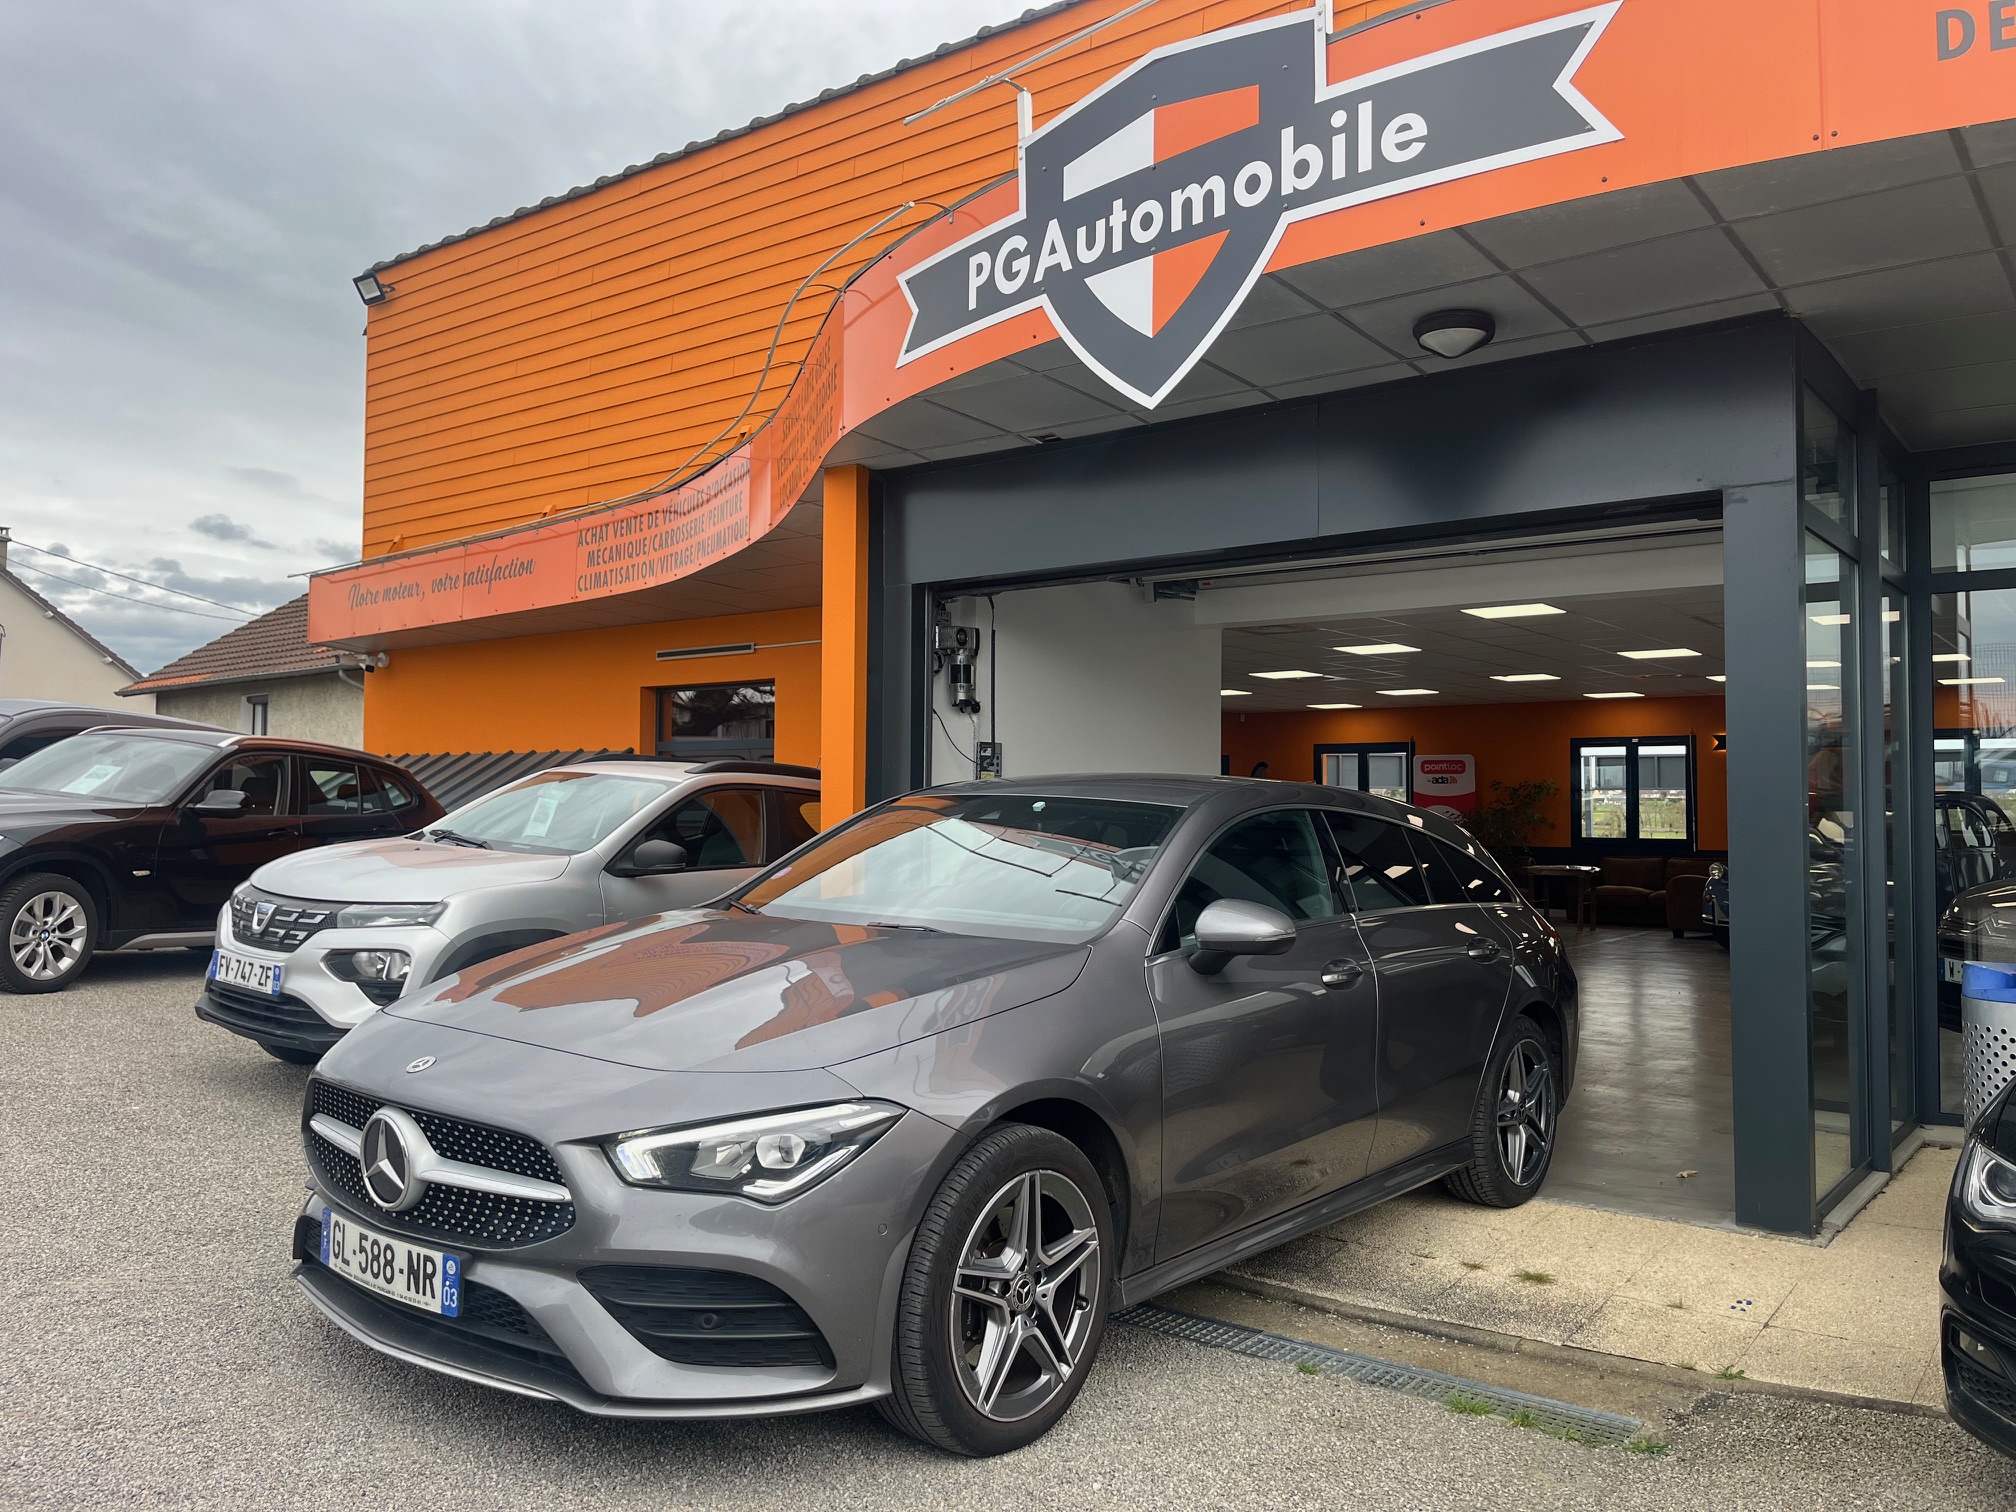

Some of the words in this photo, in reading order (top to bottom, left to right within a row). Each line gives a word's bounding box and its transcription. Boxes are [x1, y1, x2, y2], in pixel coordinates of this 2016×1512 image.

[577, 523, 610, 548] ACHAT
[612, 514, 644, 539] VENTE
[647, 509, 660, 531] DE
[662, 489, 705, 525] VÉHICULES
[705, 459, 750, 504] D'OCCASION
[348, 582, 380, 611] Notre
[382, 583, 427, 602] moteur,
[431, 573, 461, 594] votre
[463, 554, 536, 594] satisfaction
[1431, 775, 1449, 785] ada
[218, 955, 272, 987] FV-747-ZF
[332, 1220, 437, 1300] GL-588-NR
[443, 1286, 458, 1308] 03
